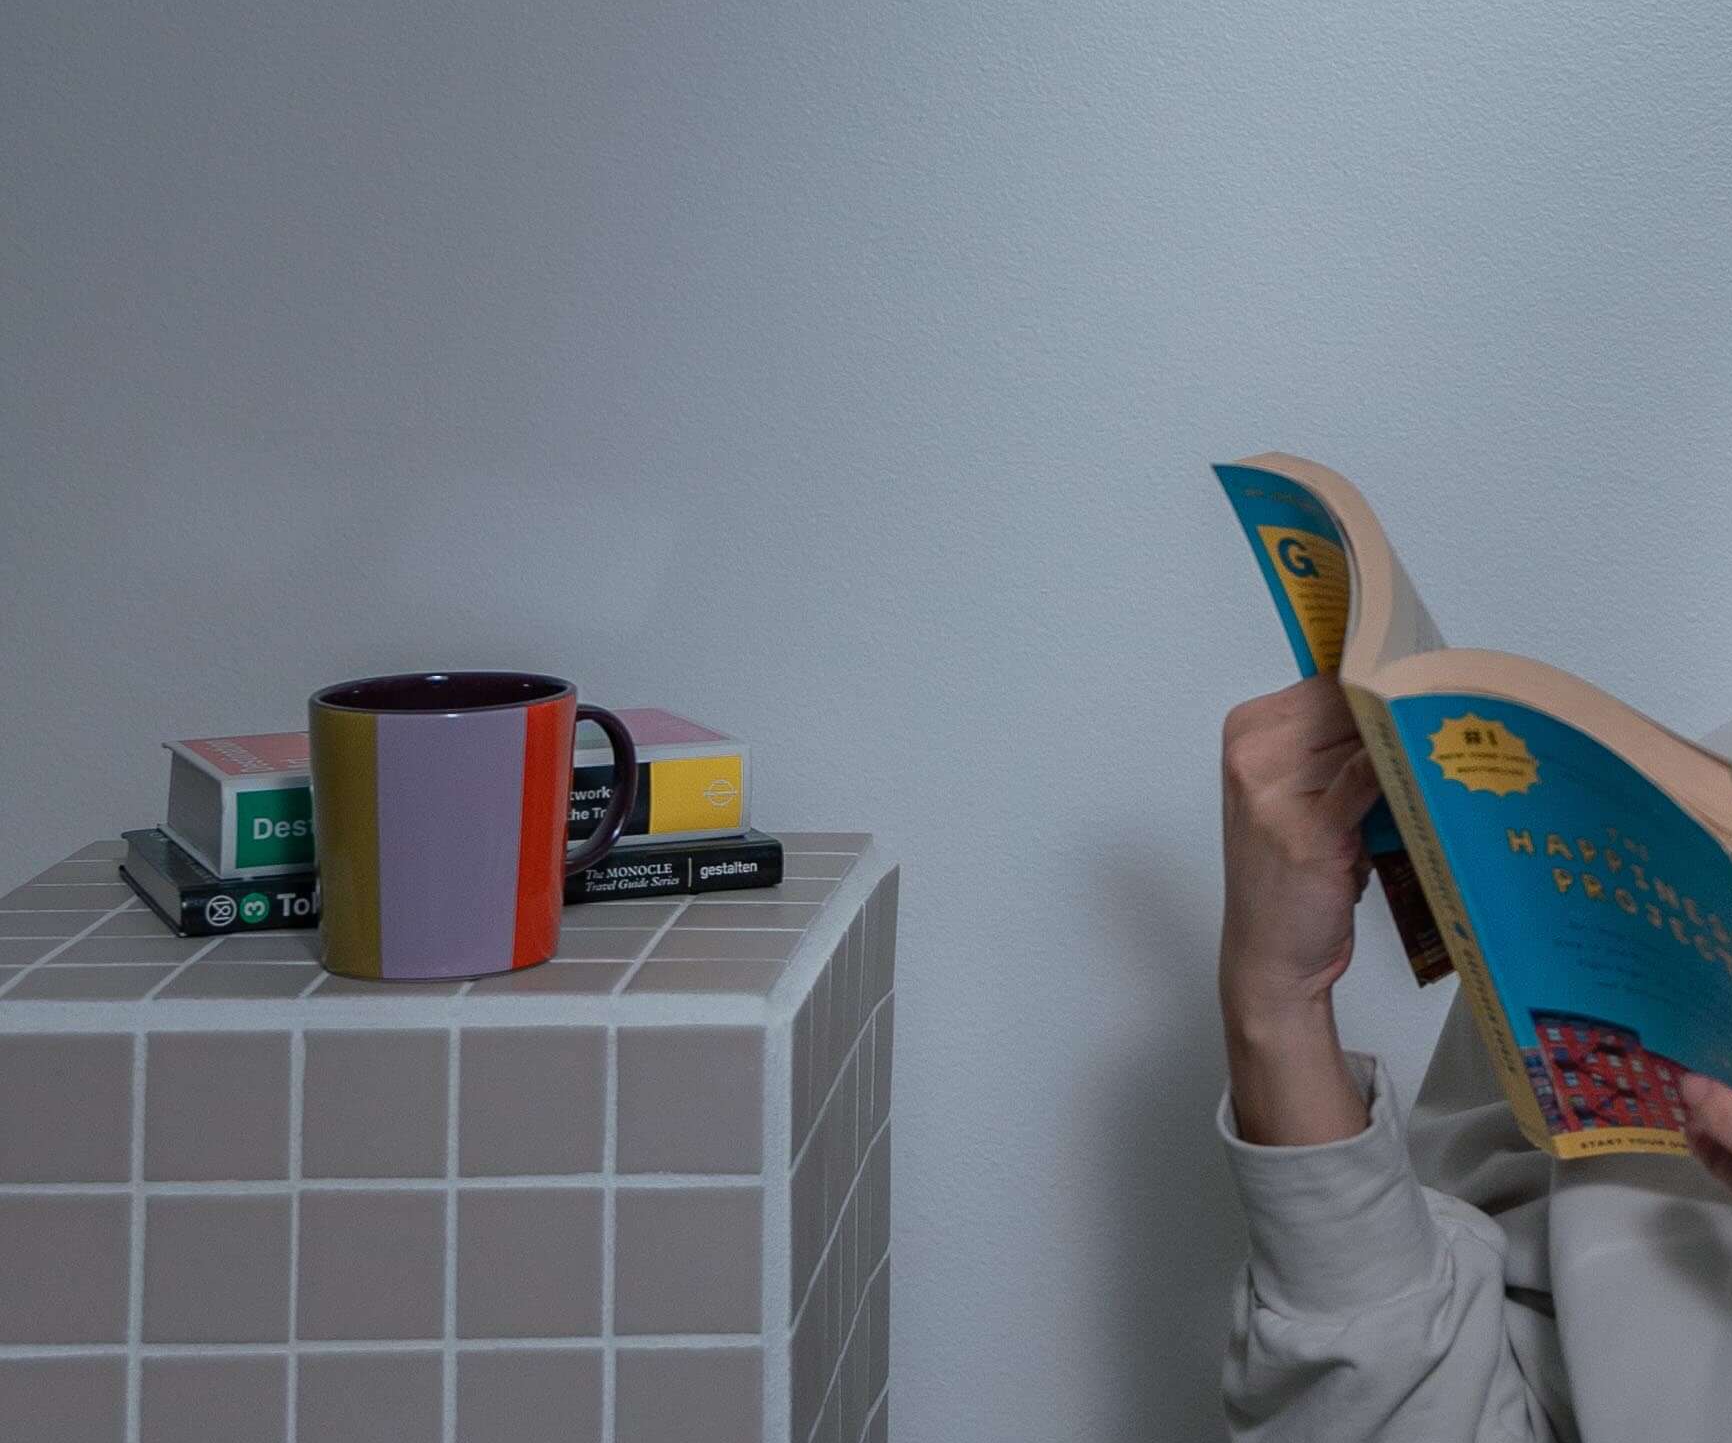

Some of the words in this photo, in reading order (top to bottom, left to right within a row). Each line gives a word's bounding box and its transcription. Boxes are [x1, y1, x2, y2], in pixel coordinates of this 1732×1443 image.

[569, 786, 614, 801] work
[584, 869, 606, 880] The
[606, 863, 673, 878] MONOCLE
[699, 860, 759, 880] gestalten
[584, 880, 617, 892] Travel
[617, 877, 649, 890] Guide
[650, 875, 681, 887] Series
